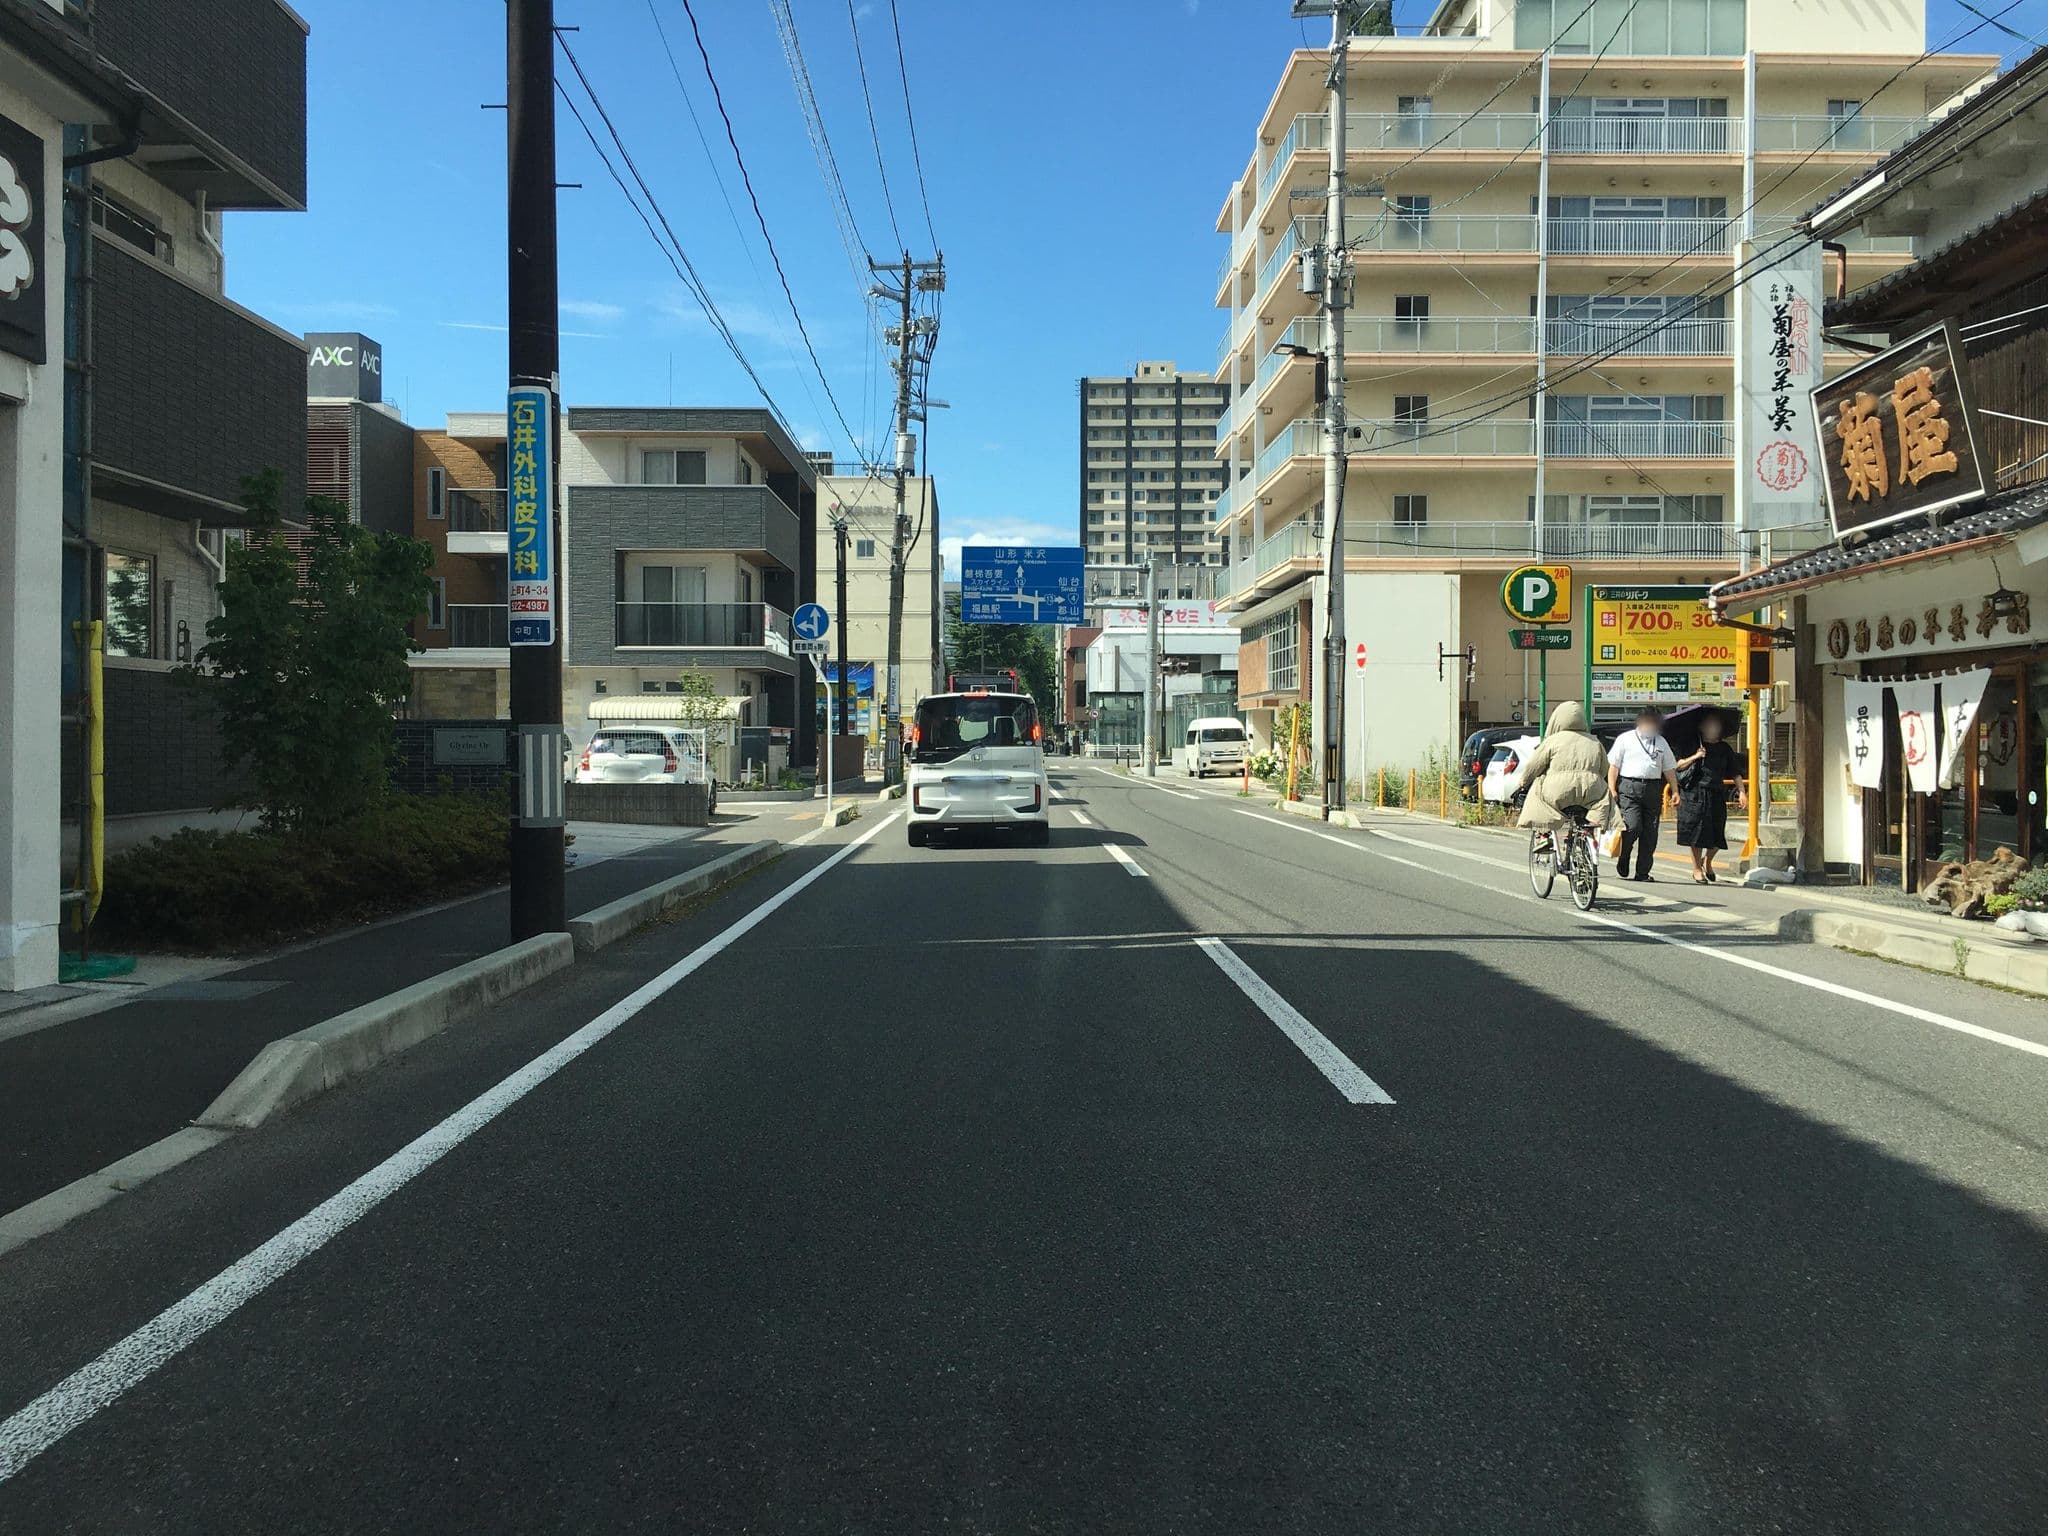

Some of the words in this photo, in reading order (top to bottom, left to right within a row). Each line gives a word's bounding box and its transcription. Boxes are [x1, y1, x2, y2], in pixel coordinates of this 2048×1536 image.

[310, 346, 353, 367] AXC
[360, 350, 380, 375] AXC
[1836, 366, 1958, 502] 菊屋
[512, 400, 539, 576] 石井外科皮フ科
[995, 548, 1017, 559] 山形
[1024, 548, 1047, 559] 米沢
[1058, 576, 1080, 587] 仙台
[1523, 577, 1550, 612] P
[972, 603, 1000, 614] 福島駅
[1058, 606, 1080, 616] 郡山
[515, 626, 533, 636] 中町
[1625, 611, 1683, 631] 700円
[1855, 705, 1870, 767] 最中
